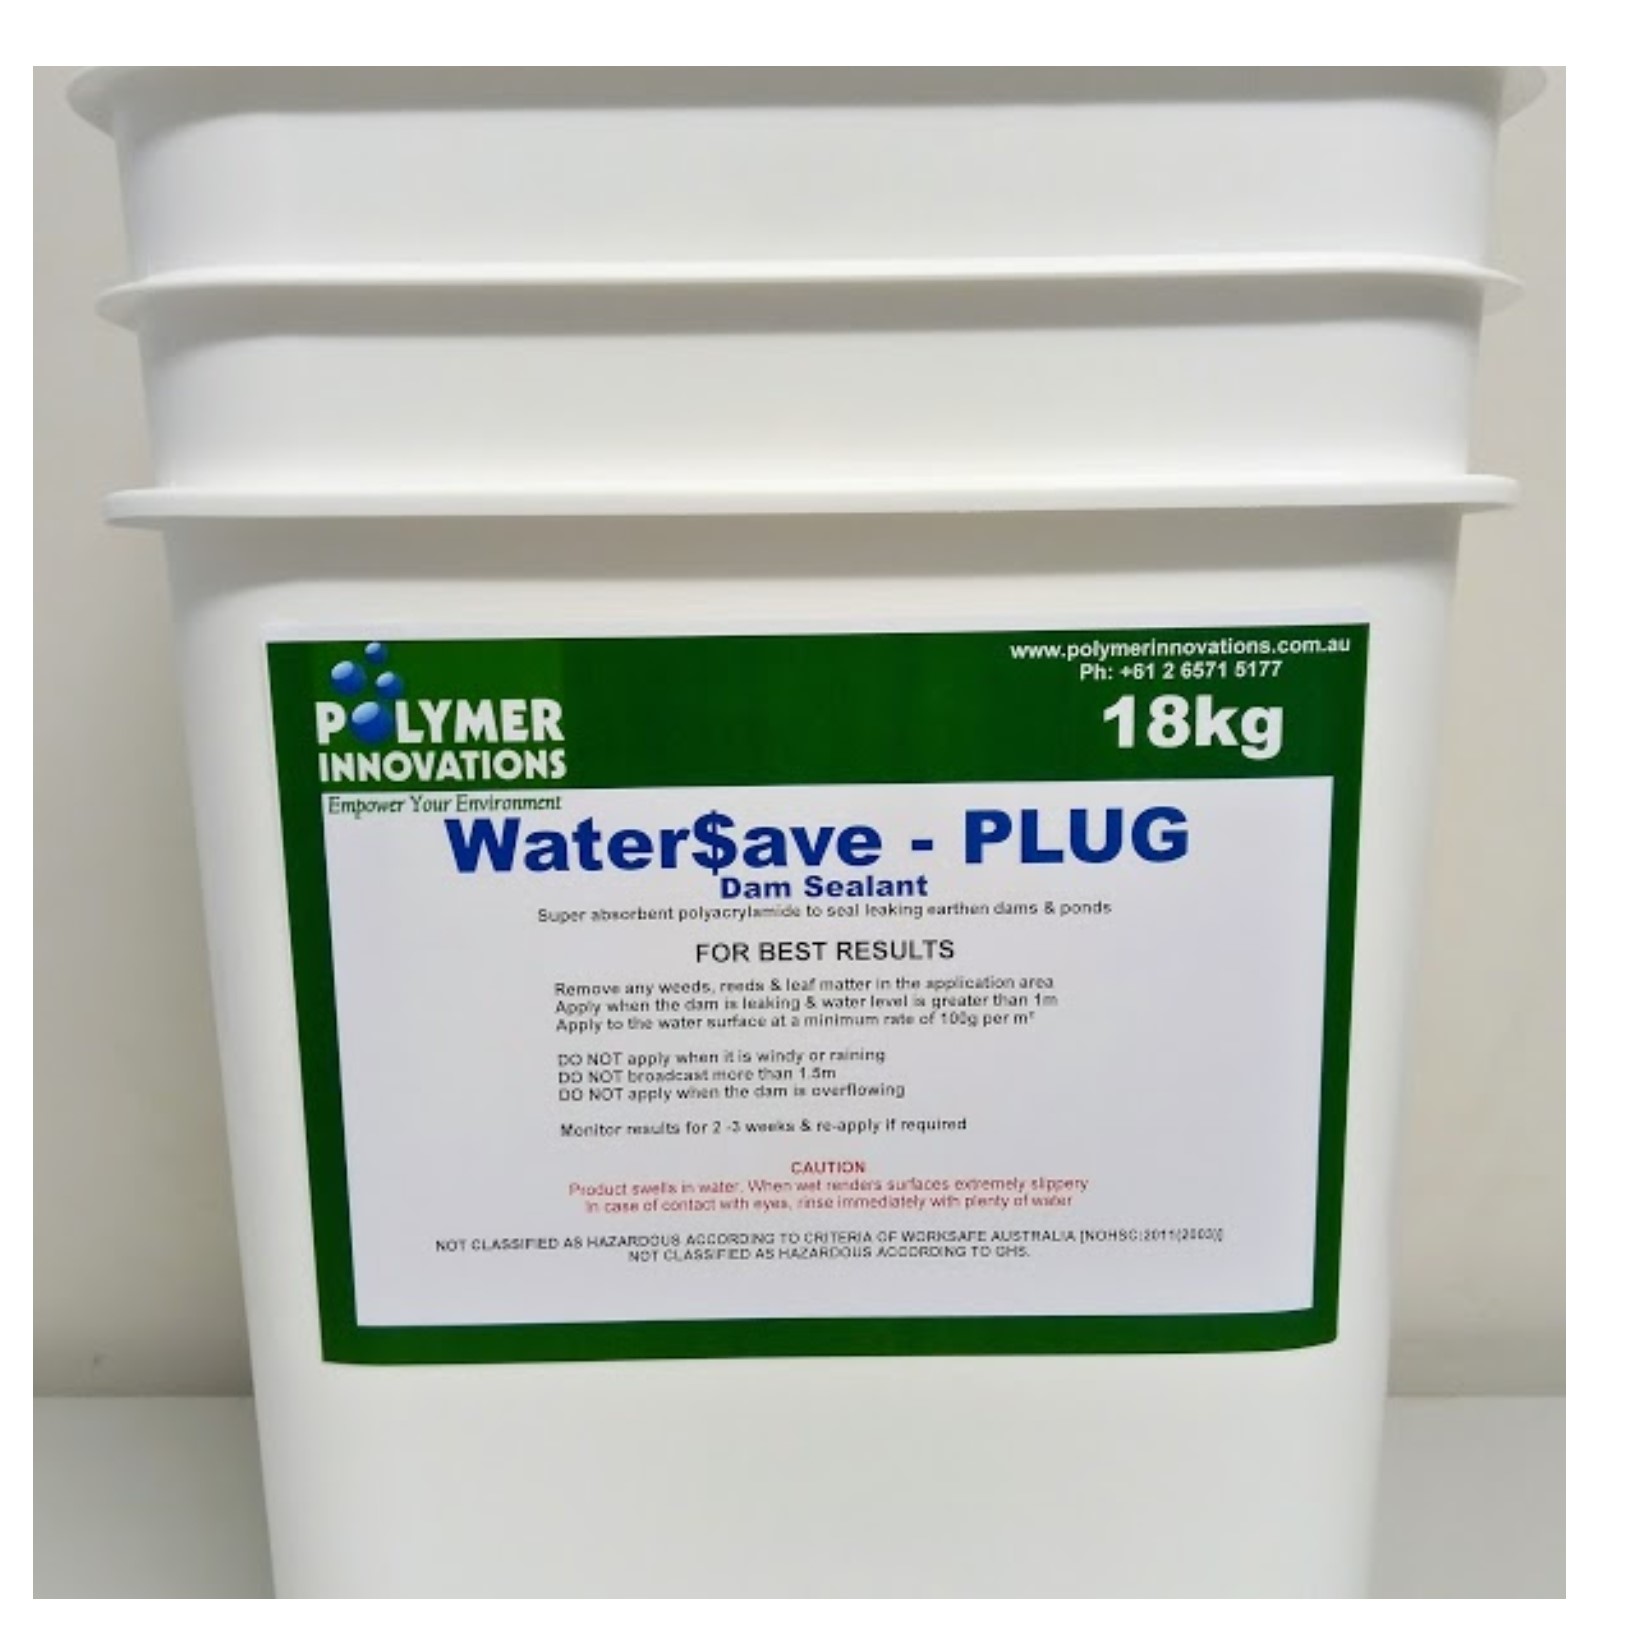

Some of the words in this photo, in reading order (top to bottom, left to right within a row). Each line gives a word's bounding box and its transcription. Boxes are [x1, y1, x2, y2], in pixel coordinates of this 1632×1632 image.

[1009, 637, 1351, 662] www.polymerinnovations.com.au
[1079, 662, 1113, 681] Ph:
[1119, 662, 1155, 680] +61
[1162, 663, 1175, 680] 2
[1179, 661, 1227, 680] 6571
[1234, 660, 1283, 678] 5177
[1103, 693, 1284, 761] 18kg
[319, 749, 567, 783] INNOVATIONS
[327, 796, 406, 819] Empower
[409, 795, 451, 813] Your
[455, 794, 563, 812] Environment
[444, 811, 883, 875] Water$ave
[965, 806, 1190, 865] PLUG
[719, 876, 792, 899] Dam
[803, 874, 929, 898] Sealant
[537, 908, 587, 925] Super
[590, 906, 675, 922] absorbent
[678, 903, 801, 923] polyacrylamide
[805, 904, 823, 918] to
[826, 902, 860, 918] seal
[865, 902, 924, 920] leaking
[926, 901, 990, 916] earthen
[992, 900, 1039, 915] dams
[1059, 900, 1113, 918] ponds
[696, 942, 750, 964] FOR
[758, 940, 828, 962] BEST
[836, 938, 955, 962] RESULTS
[554, 982, 621, 997] Remove
[624, 983, 655, 998] any
[719, 978, 765, 993] reeds
[785, 976, 816, 993] leaf
[819, 977, 872, 992] matter
[875, 978, 891, 990] in
[895, 976, 921, 990] the
[925, 975, 1016, 993] application
[1018, 977, 1054, 989] area
[555, 999, 601, 1017] Apply
[606, 998, 650, 1013] when
[654, 997, 681, 1012] the
[683, 998, 719, 1012] dam
[724, 999, 738, 1010] is
[742, 995, 801, 1012] leaking
[821, 994, 867, 1010] water
[870, 993, 908, 1009] level
[913, 997, 926, 1007] is
[931, 993, 989, 1010] greater
[992, 992, 1028, 1008] than
[1034, 991, 1058, 1007] 1m
[555, 1018, 603, 1035] Apply
[606, 1017, 624, 1030] to
[627, 1016, 653, 1031] the
[658, 1015, 703, 1031] water
[706, 1014, 767, 1029] surface
[770, 1014, 787, 1028] at
[790, 1015, 800, 1028] a
[803, 1012, 880, 1028] minimum
[883, 1013, 915, 1026] rate
[918, 1011, 936, 1025] of
[982, 1012, 1010, 1028] per
[557, 1053, 584, 1068] DO
[586, 1051, 624, 1066] NOT
[627, 1051, 670, 1069] apply
[675, 1050, 719, 1064] when
[724, 1050, 735, 1063] it
[737, 1049, 753, 1063] is
[756, 1048, 804, 1066] windy
[808, 1051, 827, 1063] or
[829, 1050, 886, 1065] raining
[558, 1070, 584, 1085] DO
[588, 1068, 624, 1084] NOT
[627, 1068, 709, 1084] broadcast
[711, 1069, 755, 1082] more
[757, 1066, 793, 1081] than
[799, 1065, 838, 1081] 1.5m
[558, 1087, 584, 1102] DO
[588, 1086, 624, 1102] NOT
[627, 1086, 673, 1104] apply
[675, 1087, 719, 1100] when
[723, 1085, 750, 1099] the
[753, 1084, 788, 1098] dam
[793, 1086, 806, 1097] is
[811, 1082, 906, 1099] overflowing
[560, 1123, 623, 1138] Monitor
[626, 1122, 681, 1136] results
[685, 1120, 709, 1135] for
[712, 1120, 722, 1134] 2
[744, 1120, 795, 1134] weeks
[816, 1117, 880, 1135] re-apply
[885, 1117, 896, 1132] if
[900, 1117, 967, 1135] required
[790, 1160, 866, 1175] CAUTION
[568, 1182, 627, 1197] Product
[631, 1181, 678, 1196] swells
[681, 1183, 695, 1195] in
[747, 1179, 793, 1194] When
[794, 1178, 822, 1192] wet
[826, 1178, 883, 1192] renders
[886, 1177, 951, 1192] surfaces
[954, 1176, 1026, 1194] extremely
[1030, 1176, 1090, 1194] slippery
[585, 1200, 599, 1213] In
[604, 1201, 640, 1214] case
[642, 1197, 659, 1212] of
[660, 1198, 716, 1212] contact
[719, 1196, 750, 1210] with
[797, 1195, 834, 1209] rinse
[836, 1194, 926, 1212] immediately
[929, 1194, 961, 1209] with
[964, 1194, 1010, 1212] plenty
[1013, 1193, 1029, 1207] of
[1031, 1194, 1072, 1207] water
[435, 1239, 466, 1253] NOT
[471, 1236, 560, 1251] CLASSIFIED
[563, 1235, 584, 1250] AS
[586, 1234, 681, 1249] HAZARDOUS
[686, 1232, 775, 1247] ACCORDING
[778, 1232, 801, 1246] TO
[803, 1230, 873, 1245] CRITERIA
[876, 1231, 898, 1244] OF
[900, 1230, 988, 1244] WORKSAFE
[990, 1229, 1077, 1243] AUSTRALIA
[628, 1250, 659, 1263] NOT
[663, 1248, 752, 1262] CLASSIFIED
[754, 1247, 775, 1260] AS
[778, 1246, 873, 1259] HAZARDOUS
[875, 1245, 967, 1258] ACCORDING
[970, 1245, 992, 1258] TO
